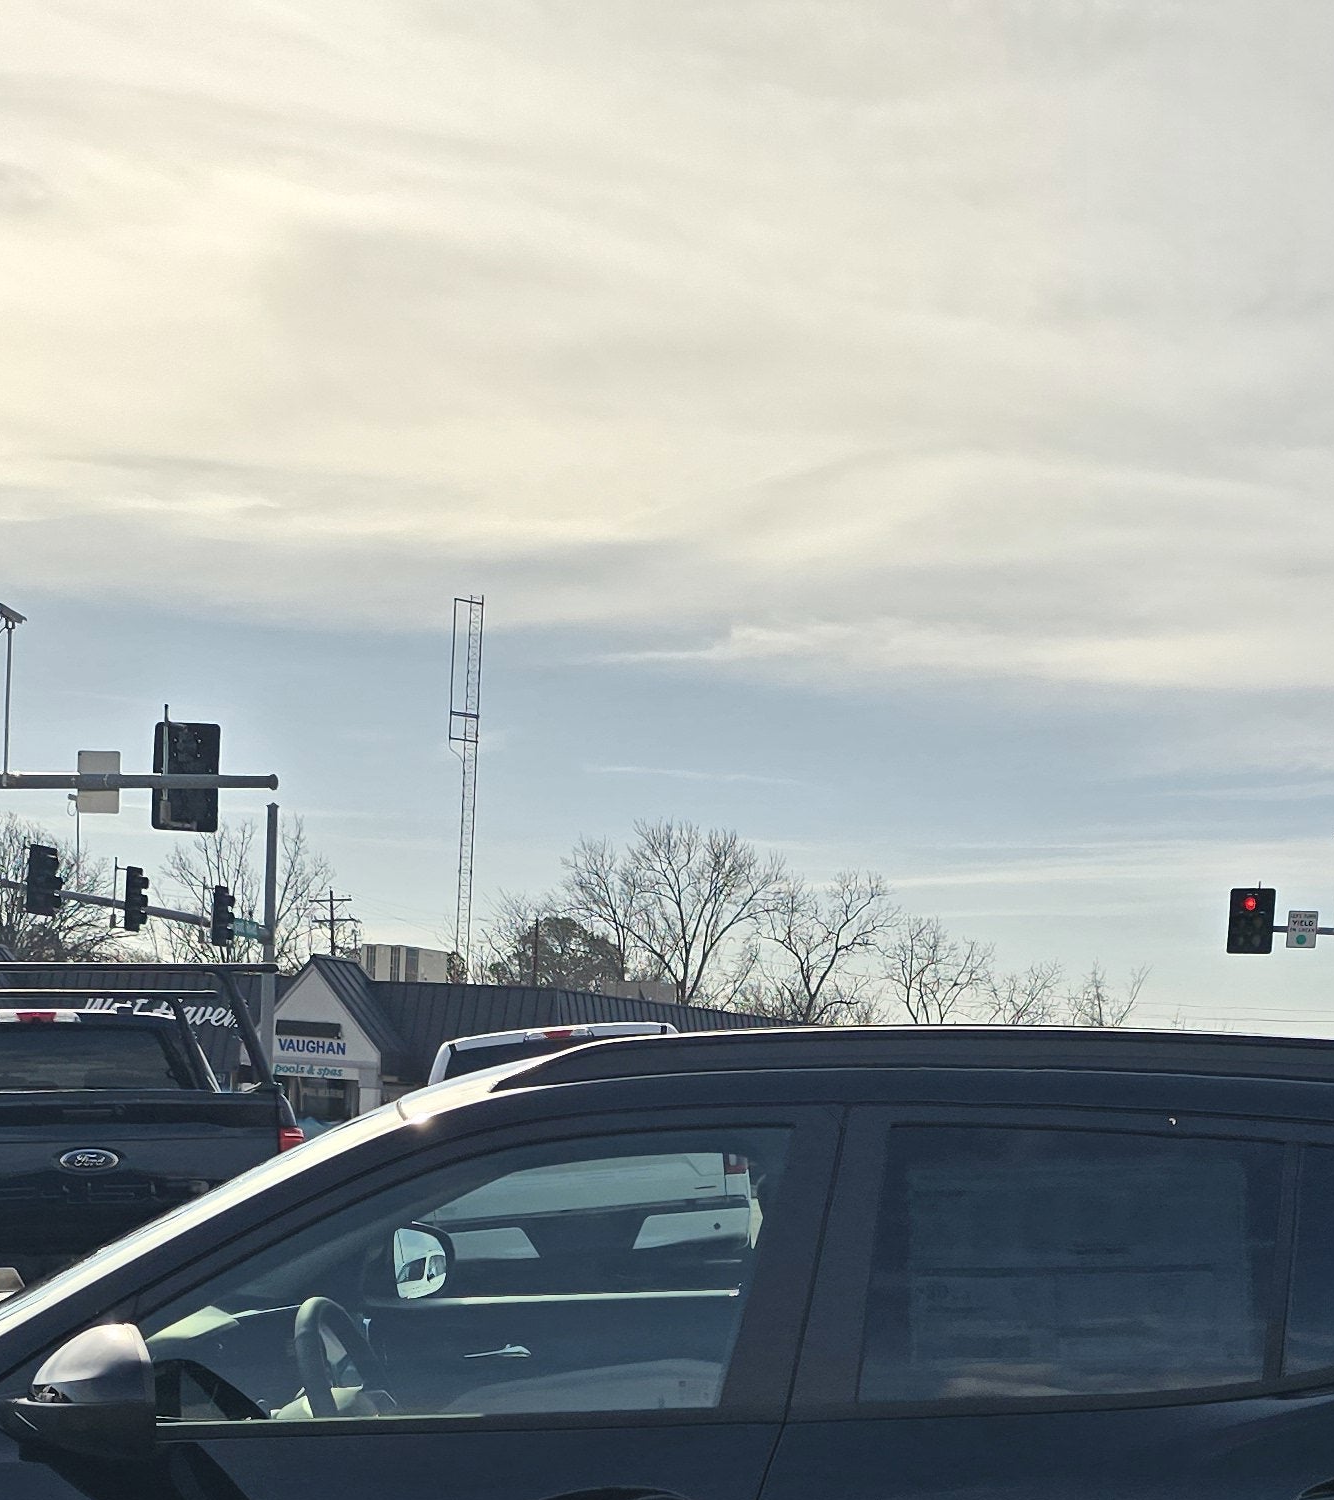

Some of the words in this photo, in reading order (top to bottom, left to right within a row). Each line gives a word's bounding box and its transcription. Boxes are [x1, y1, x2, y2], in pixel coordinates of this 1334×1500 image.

[278, 1038, 346, 1056] VAUGHAN
[274, 1063, 305, 1074] pools
[307, 1065, 314, 1075] &
[317, 1067, 343, 1079] spas
[74, 1154, 106, 1167] Ford
